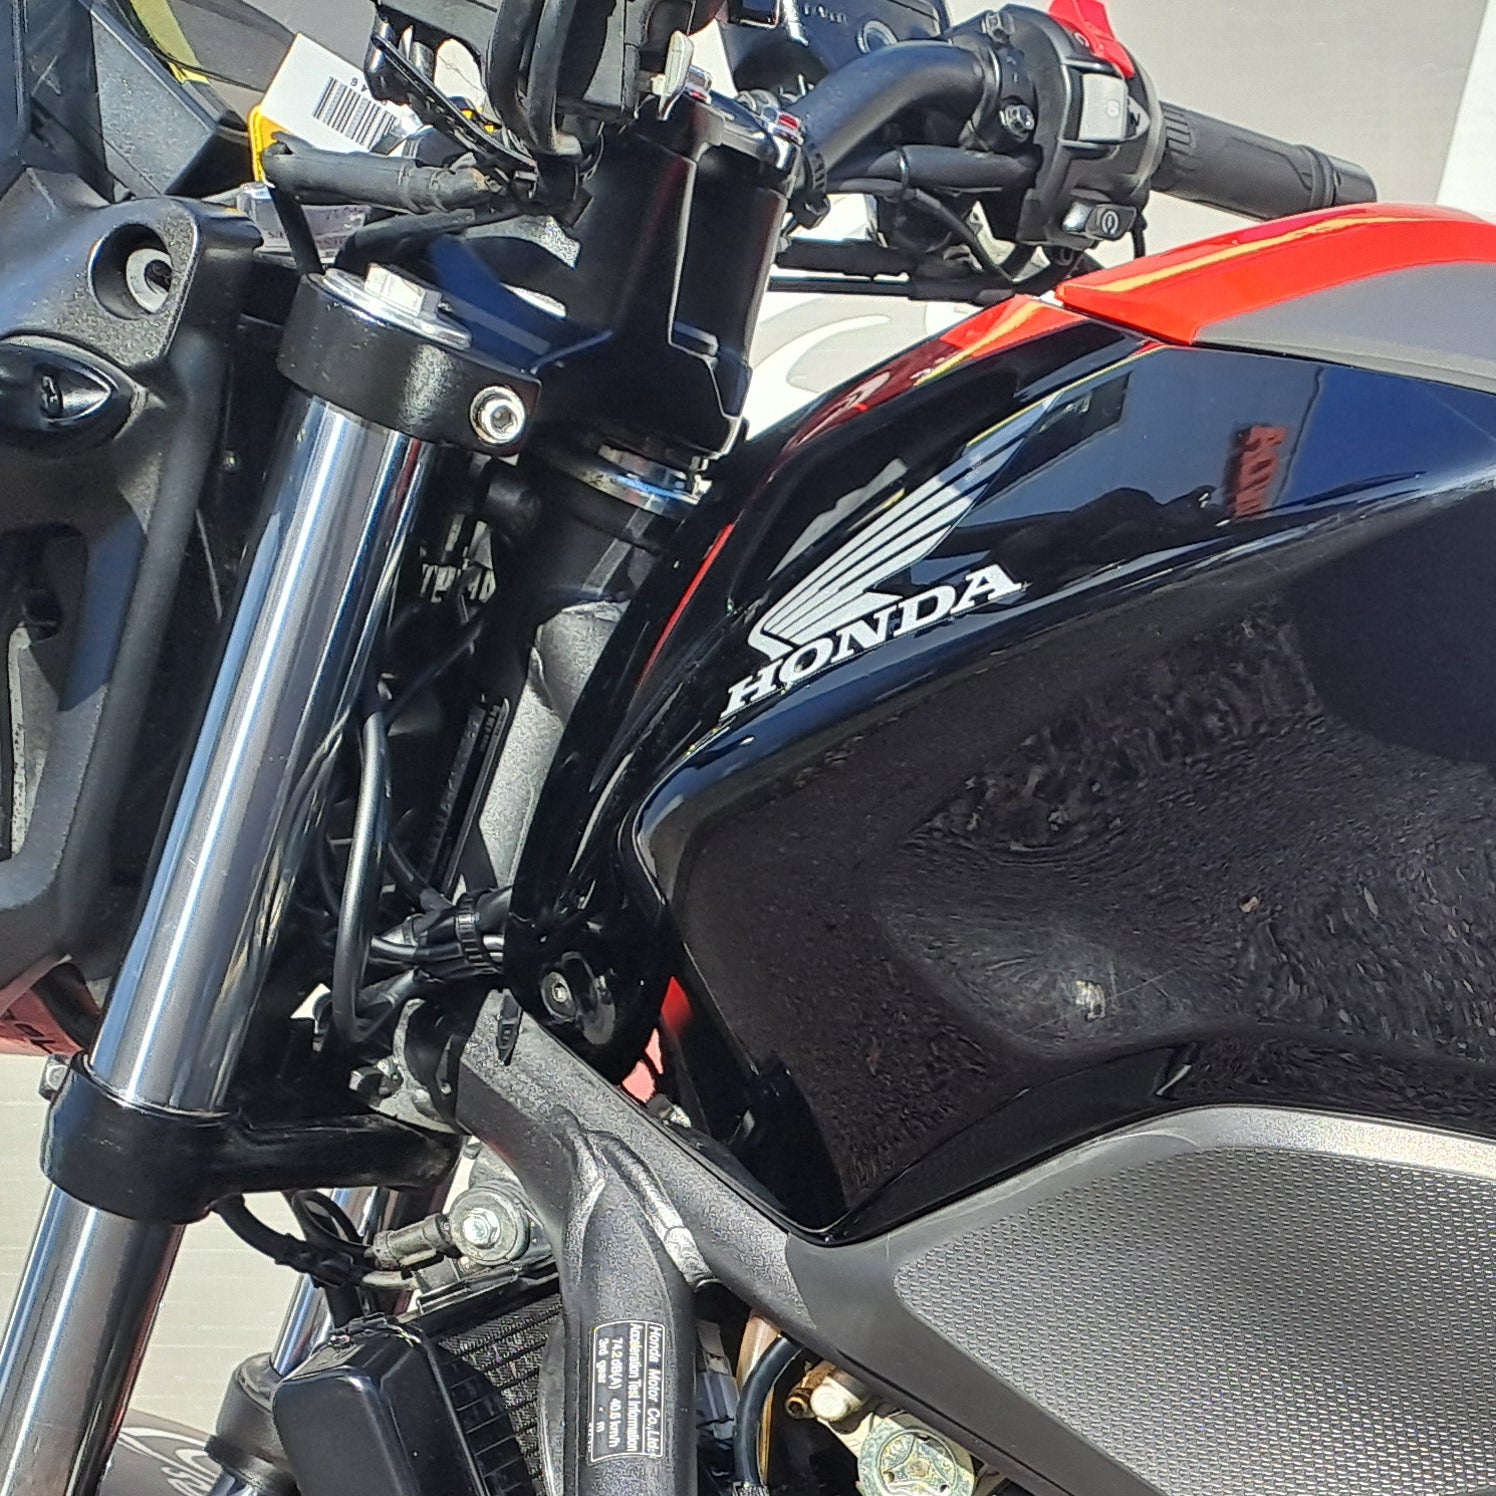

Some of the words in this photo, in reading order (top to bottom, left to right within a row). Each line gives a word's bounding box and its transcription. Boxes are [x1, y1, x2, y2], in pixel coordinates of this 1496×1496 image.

[719, 563, 1023, 719] HONDA
[598, 1338, 609, 1356] 3rd
[628, 1323, 643, 1378] Acceleration
[648, 1326, 662, 1363] Honda
[596, 1360, 607, 1384] gear
[608, 1359, 623, 1390] dB(A)
[647, 1369, 661, 1402] Motor
[627, 1379, 641, 1399] Test
[608, 1421, 621, 1448] km/h
[626, 1401, 640, 1452] Information
